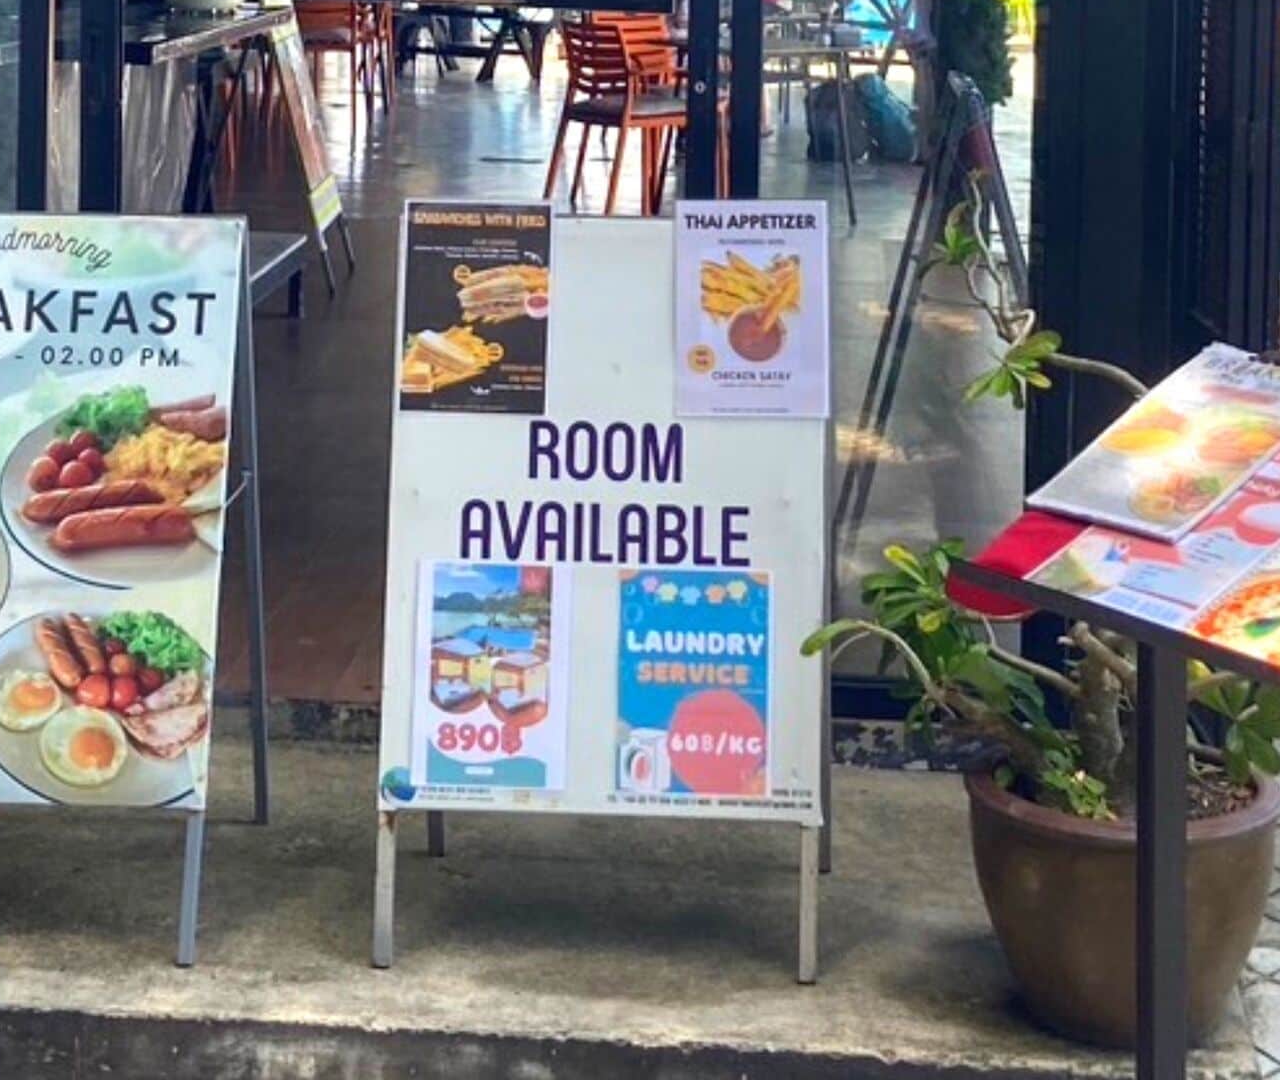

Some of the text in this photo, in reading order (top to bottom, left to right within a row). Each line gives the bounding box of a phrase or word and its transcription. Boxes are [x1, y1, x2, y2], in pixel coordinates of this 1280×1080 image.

[684, 214, 817, 230] THAI APPETIZER
[40, 345, 123, 366] 02.00
[139, 347, 181, 367] PM
[528, 420, 683, 483] ROOM
[460, 498, 750, 567] AVAILABLE
[626, 628, 765, 656] LAUNDRY
[637, 660, 751, 685] SERVICE
